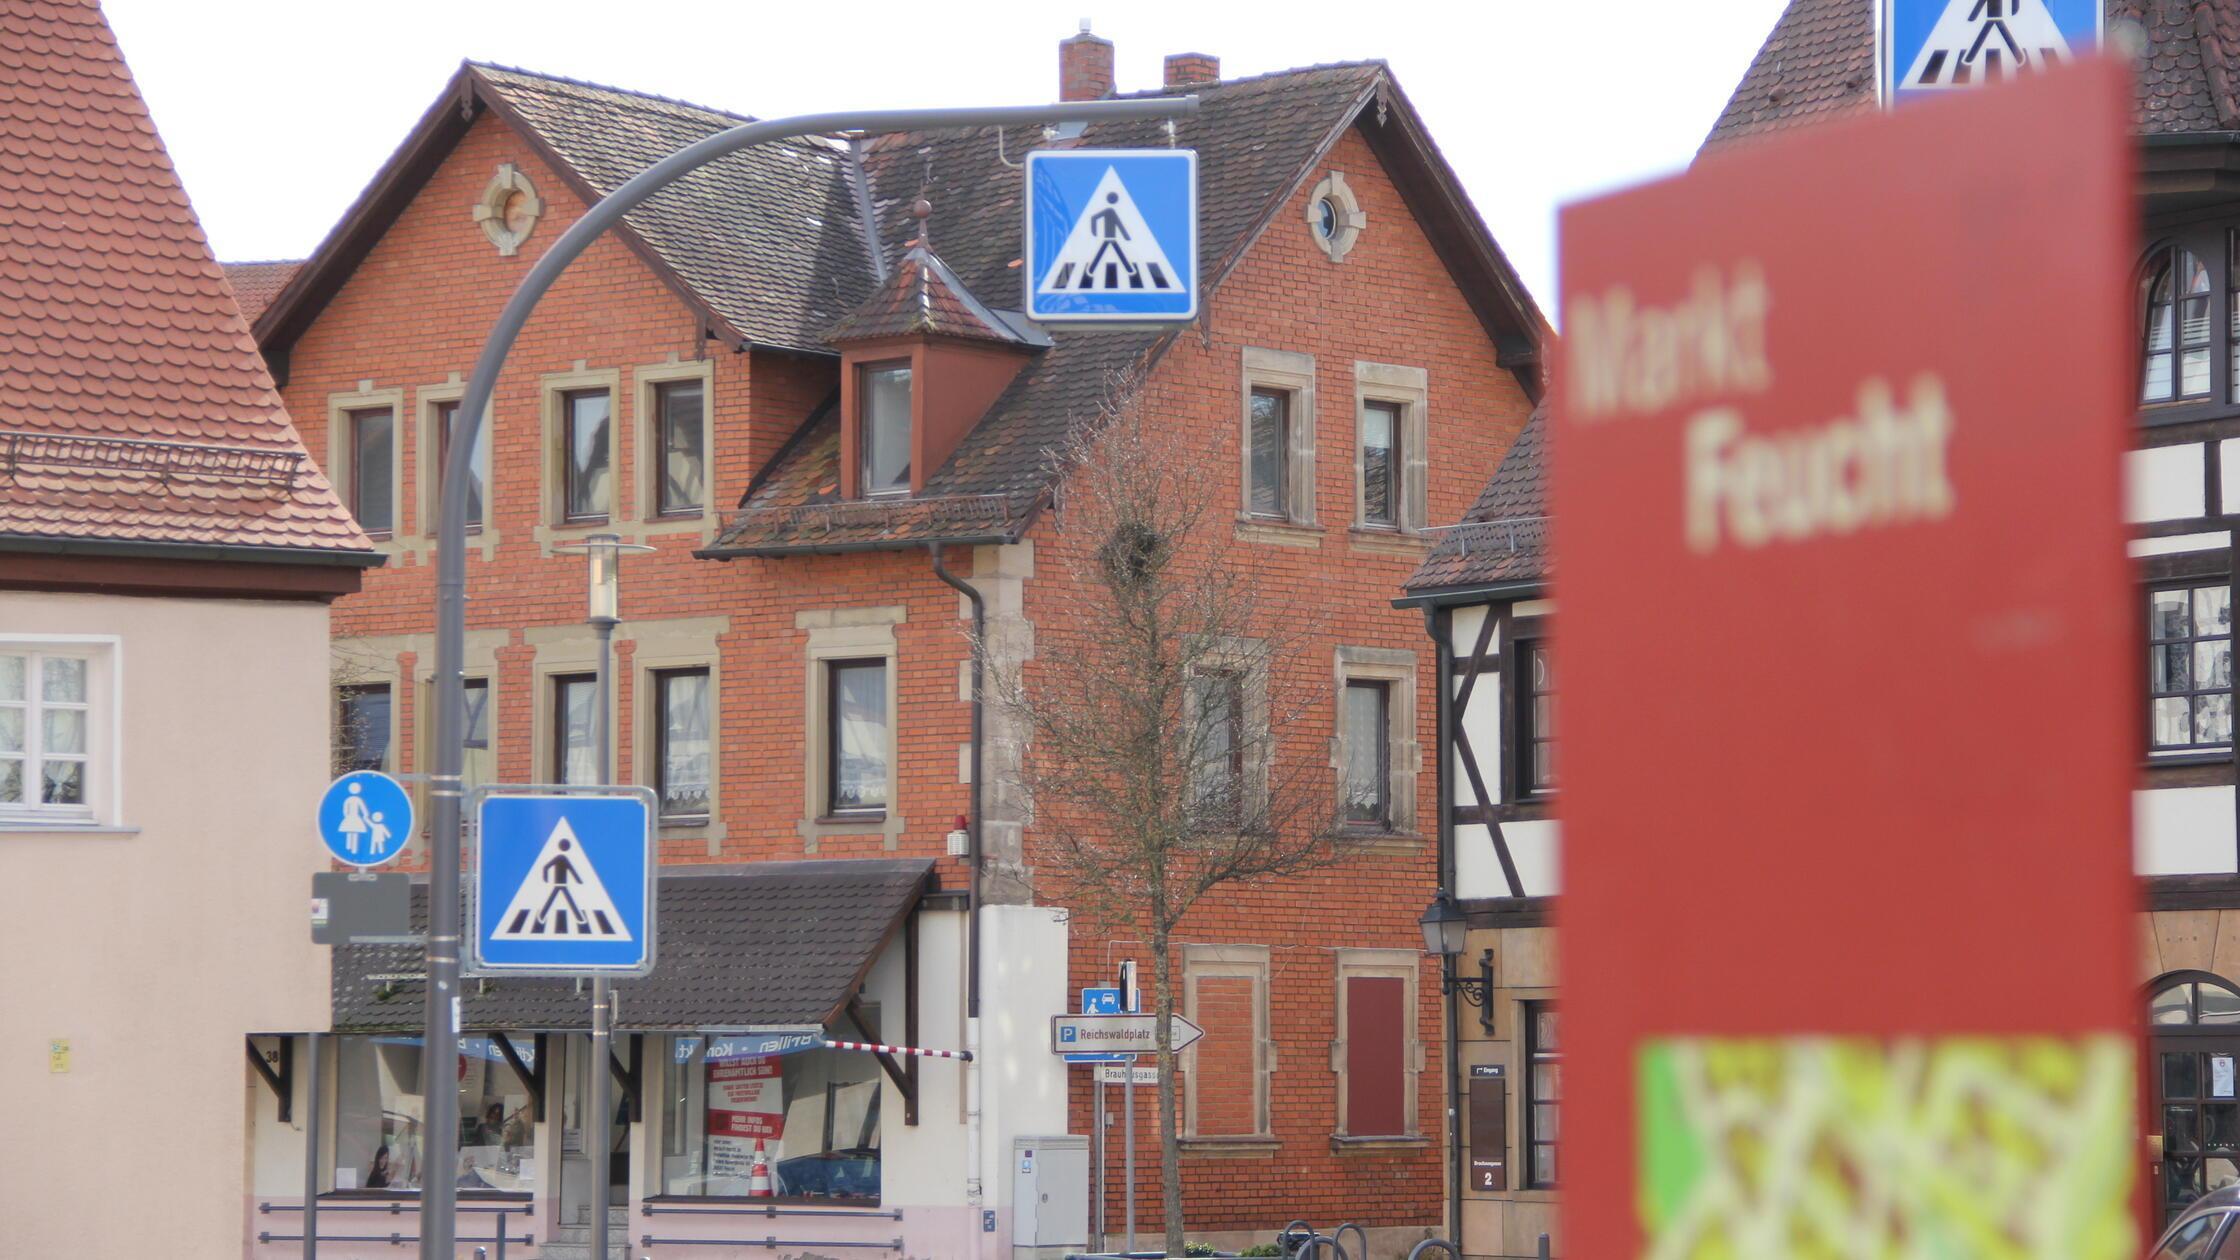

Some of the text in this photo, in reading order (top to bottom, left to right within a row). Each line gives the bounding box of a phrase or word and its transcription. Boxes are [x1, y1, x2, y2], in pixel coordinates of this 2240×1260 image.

[1569, 256, 1770, 424] Markt
[1687, 372, 1952, 551] Feucht
[1063, 1028, 1150, 1042] P Reichswaldplatz
[266, 1050, 278, 1063] 38
[1105, 1069, 1160, 1081] Brauhusgass
[1484, 1172, 1493, 1186] 2
